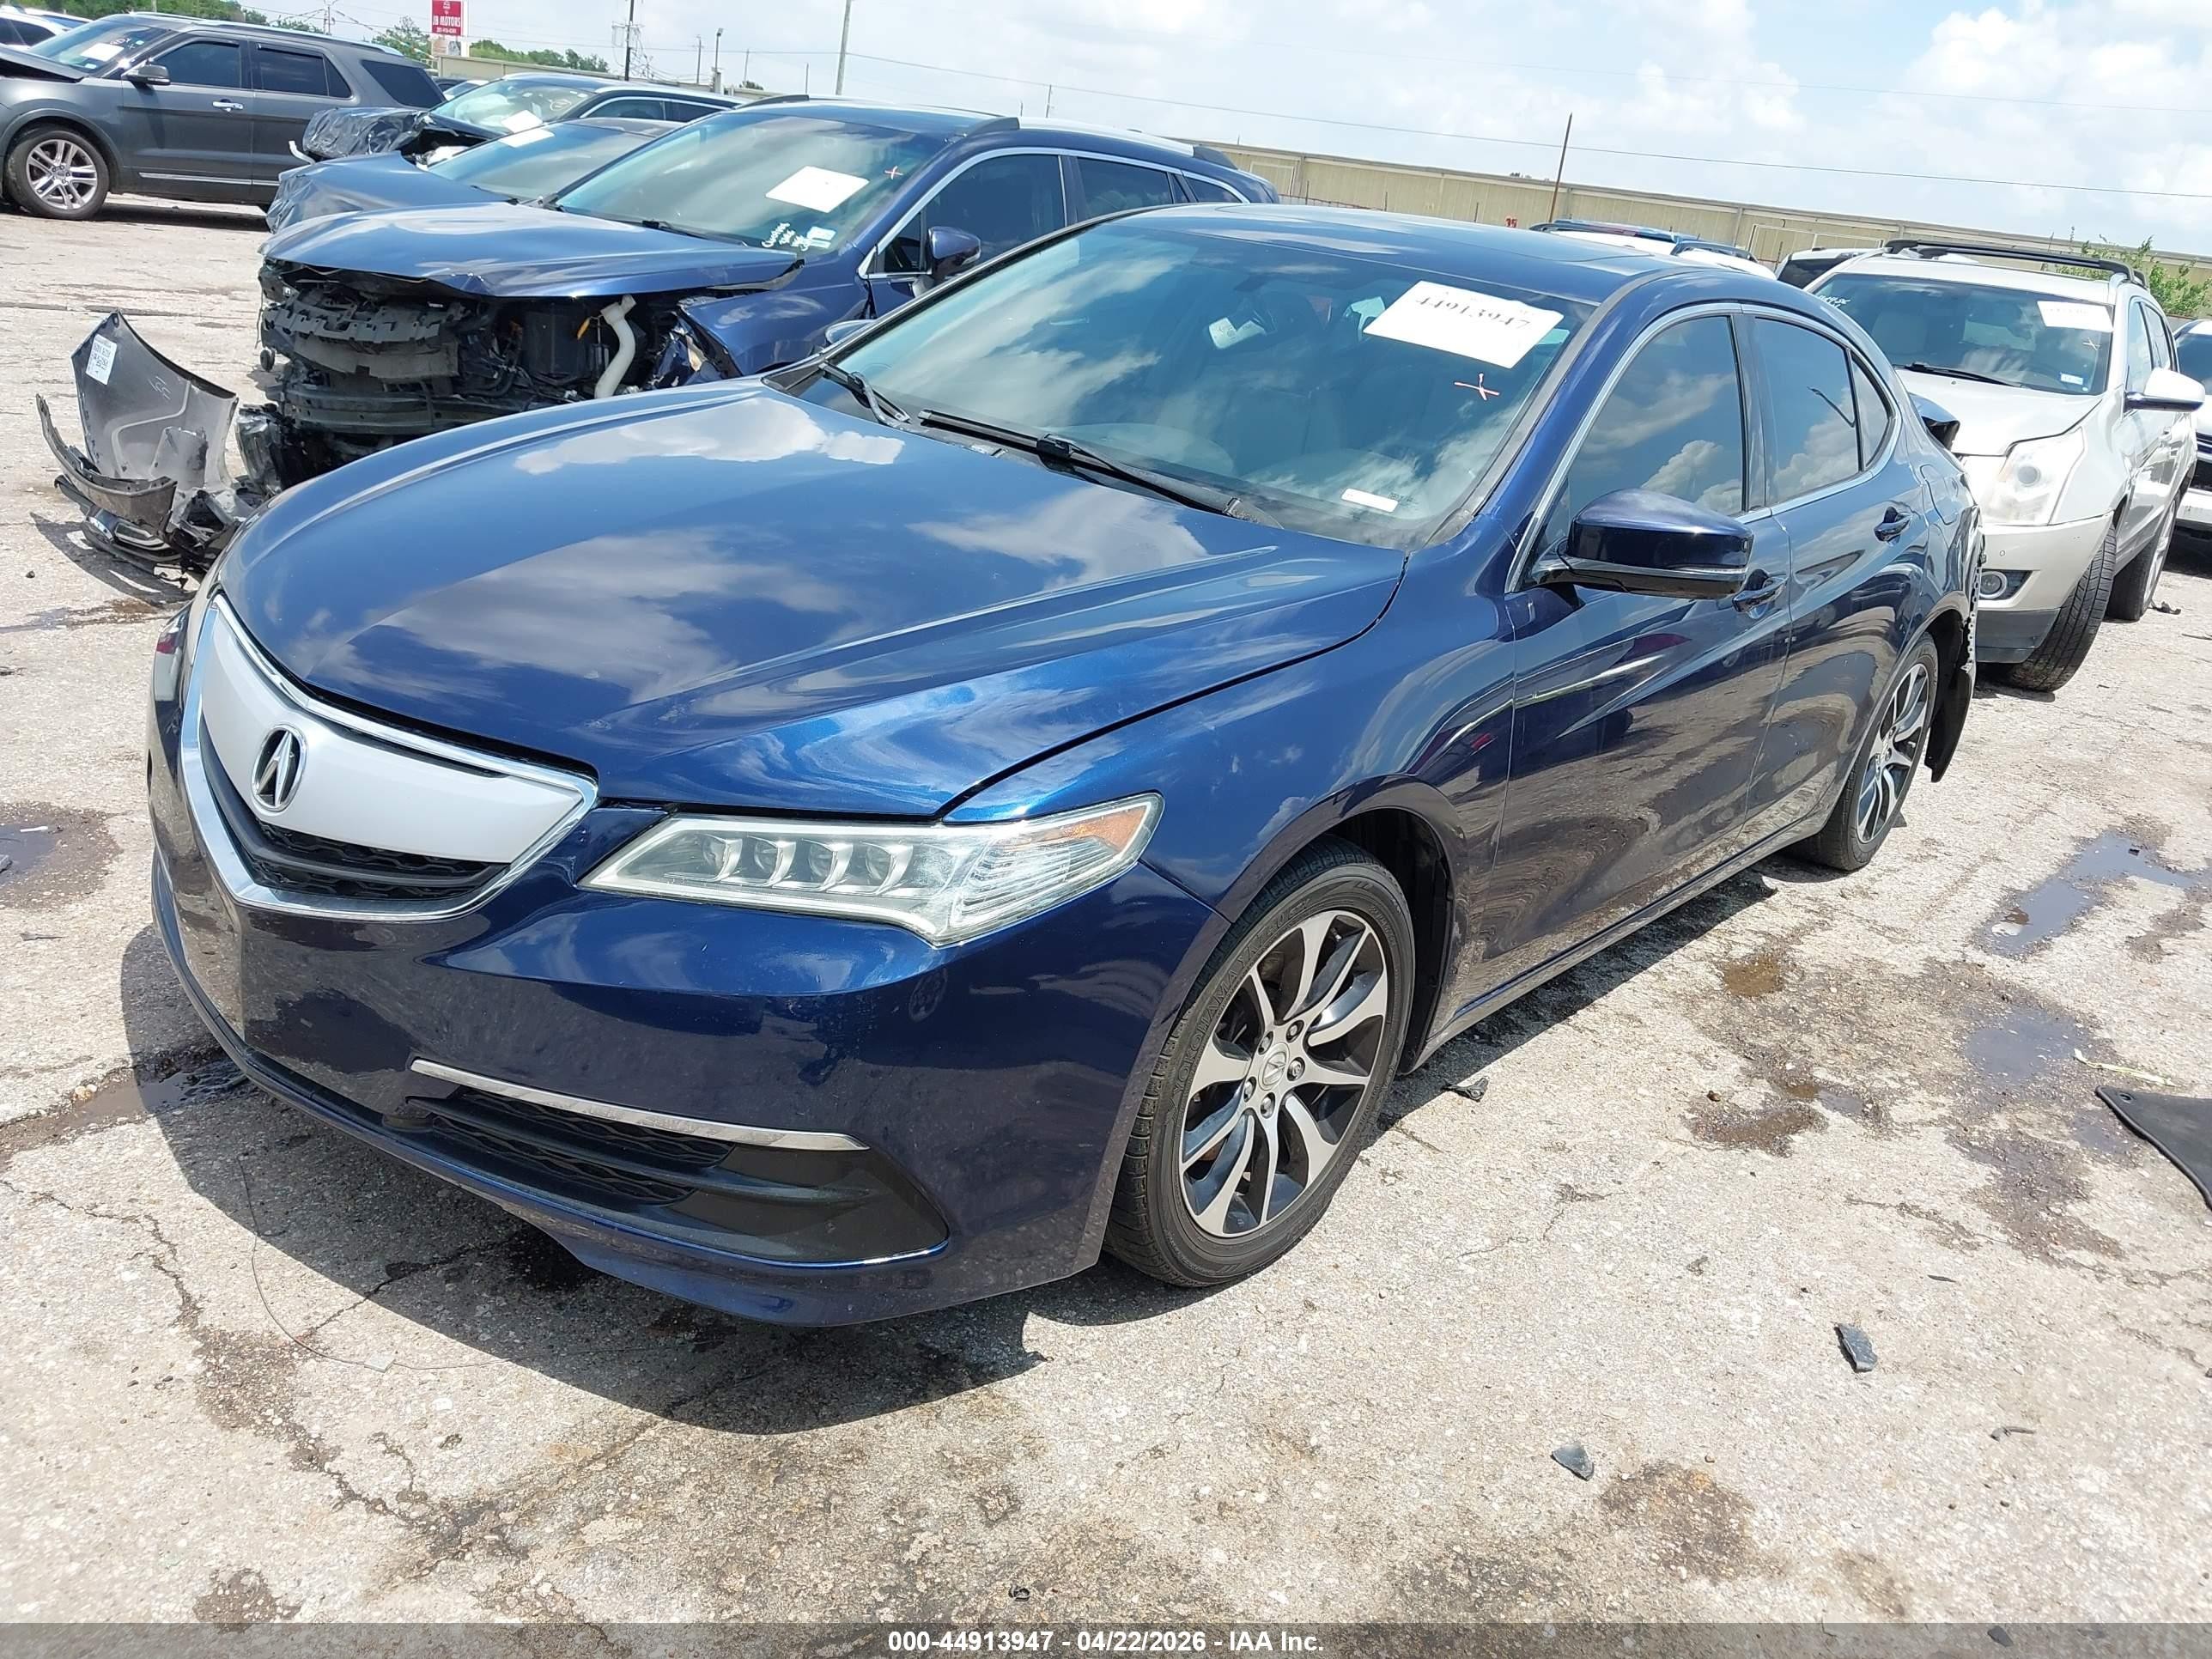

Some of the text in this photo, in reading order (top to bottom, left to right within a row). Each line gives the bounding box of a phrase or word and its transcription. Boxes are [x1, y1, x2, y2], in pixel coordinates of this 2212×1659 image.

[440, 15, 461, 27] MOTORS
[1416, 297, 1531, 329] 44913947
[1173, 967, 1238, 1096] YOKOHAMA
